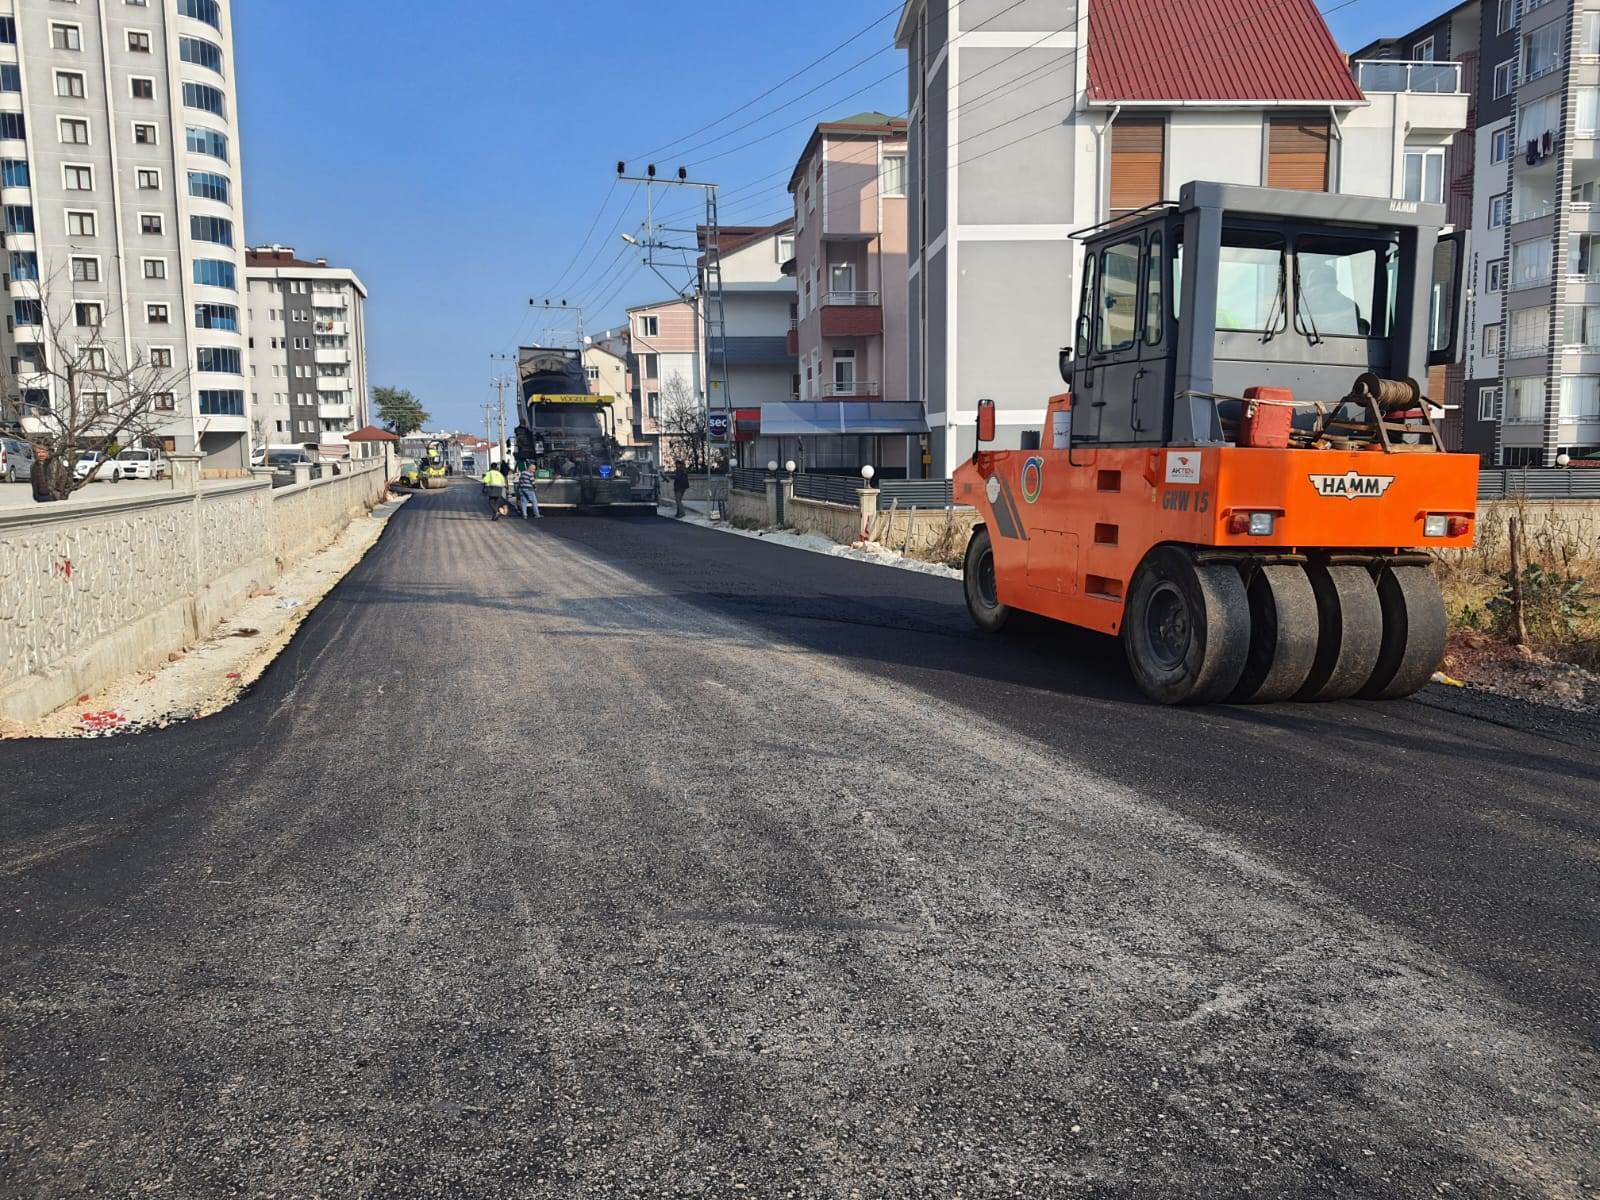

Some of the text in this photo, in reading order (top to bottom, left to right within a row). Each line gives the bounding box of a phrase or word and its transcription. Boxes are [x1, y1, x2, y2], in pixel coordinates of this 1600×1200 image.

[1389, 200, 1418, 213] HAMM
[1322, 477, 1380, 494] HAMM
[1193, 490, 1209, 513] 15
